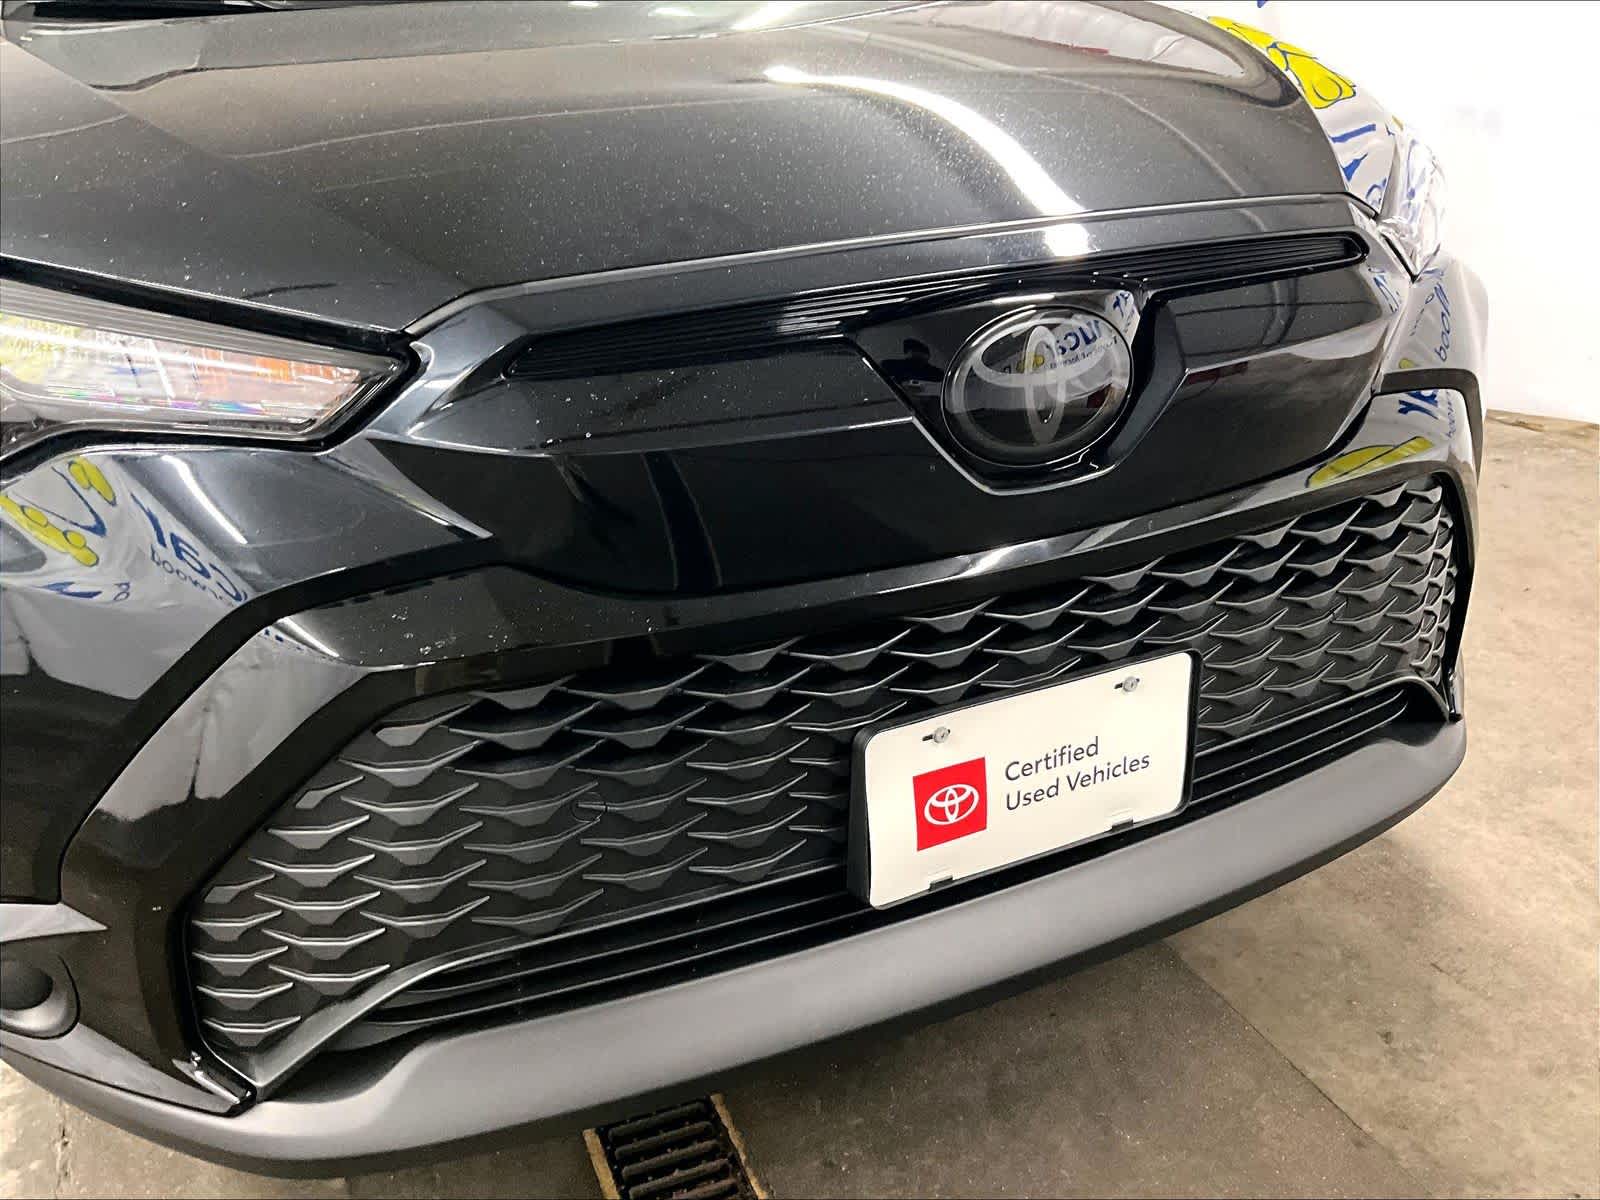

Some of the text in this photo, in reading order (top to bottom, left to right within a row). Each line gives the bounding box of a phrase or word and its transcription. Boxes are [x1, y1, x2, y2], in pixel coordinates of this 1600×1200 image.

[1004, 735, 1099, 782] Certified
[1005, 754, 1151, 811] Used Vehicles
